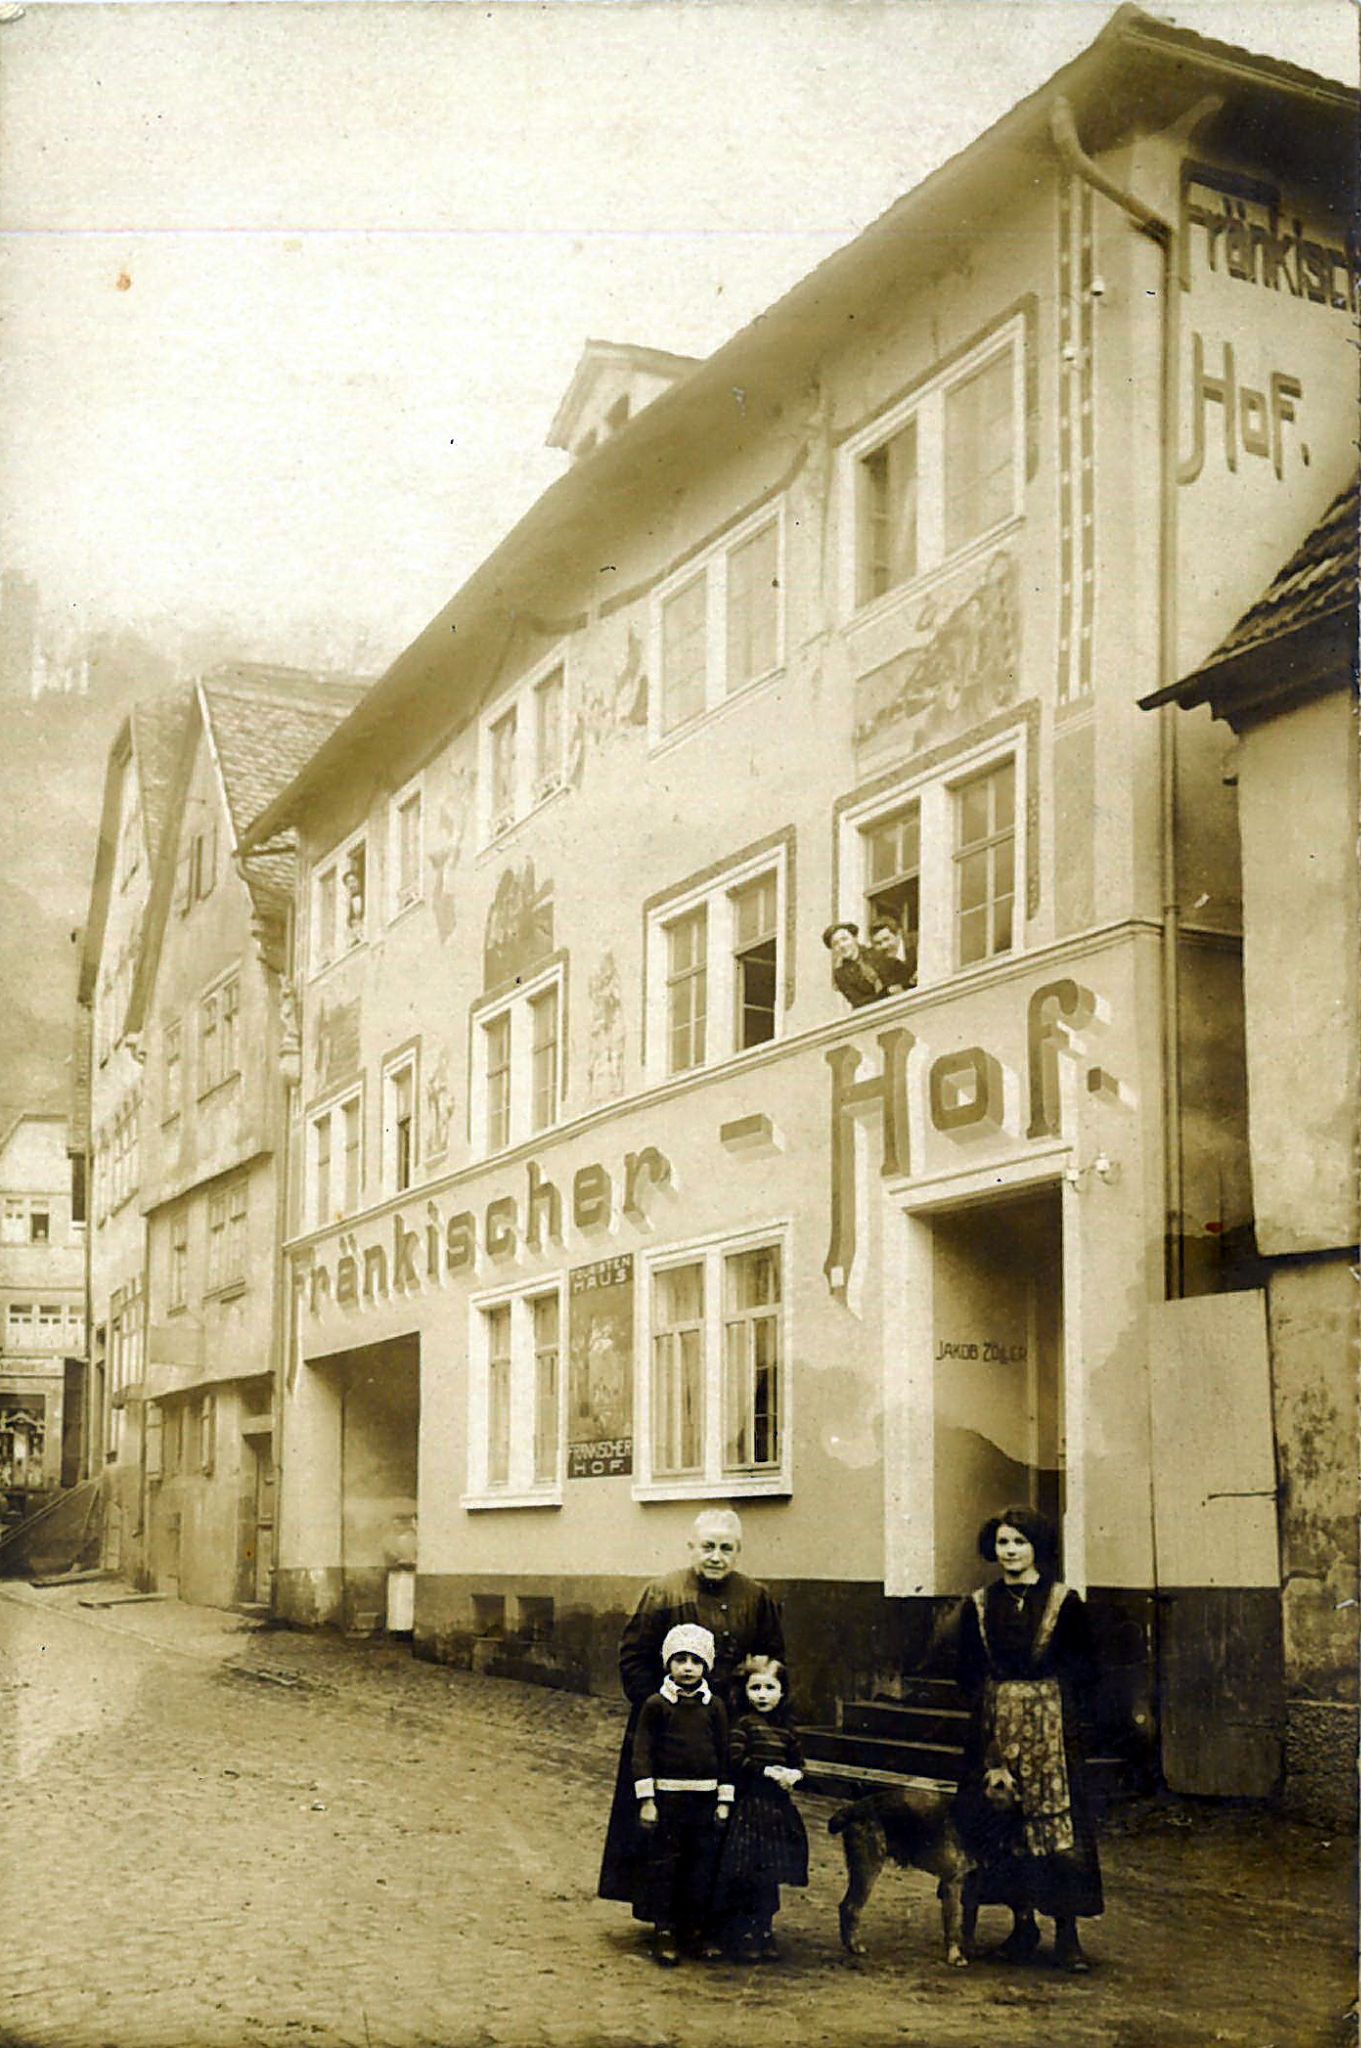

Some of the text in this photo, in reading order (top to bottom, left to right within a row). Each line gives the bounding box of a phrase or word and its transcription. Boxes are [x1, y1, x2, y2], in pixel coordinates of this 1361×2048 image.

[288, 1146, 677, 1388] Fränkischer
[574, 1268, 627, 1294] HAUS
[936, 1341, 979, 1361] JAKOB
